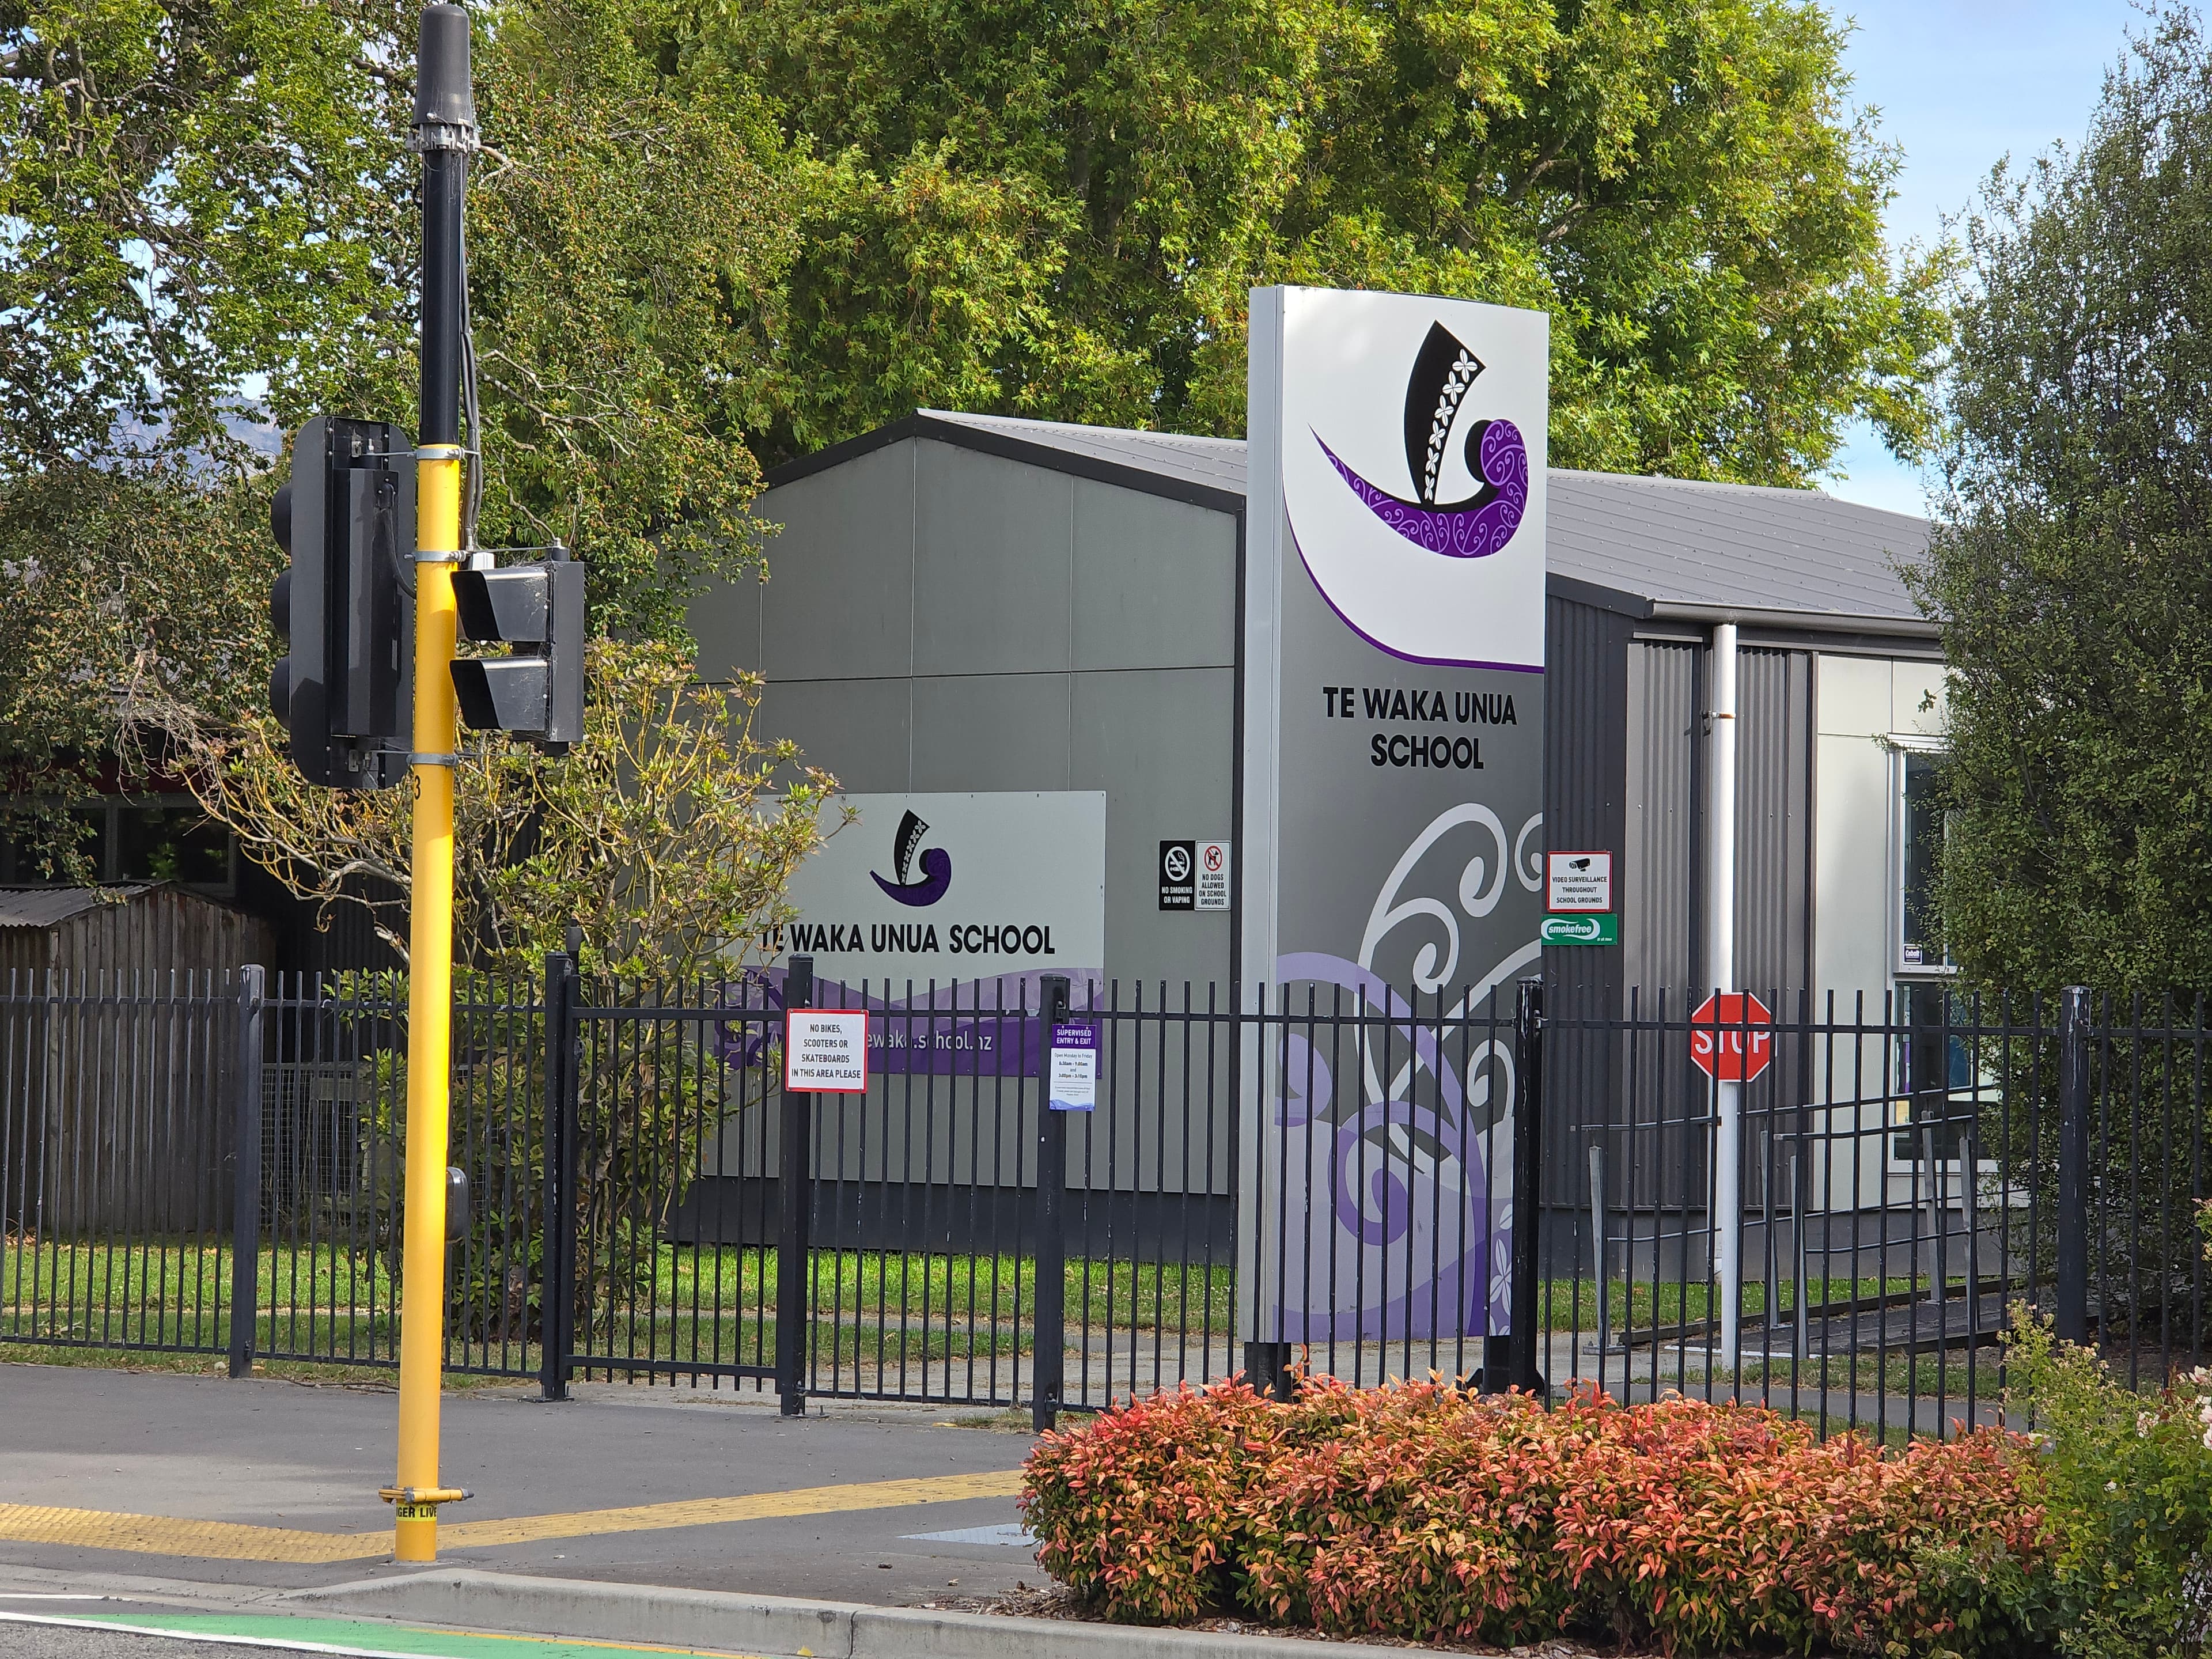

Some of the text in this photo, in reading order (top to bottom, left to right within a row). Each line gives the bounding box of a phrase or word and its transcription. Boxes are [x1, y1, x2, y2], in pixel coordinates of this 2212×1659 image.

[1323, 687, 1517, 725] TE WAKA UNUA
[1370, 733, 1484, 769] SCHOOL
[1548, 924, 1592, 933] smokefree
[790, 924, 865, 952] WAKA
[872, 924, 940, 952] UNUA
[949, 924, 1055, 955] SCHOOL
[810, 1024, 842, 1035] NO BIKES,
[1695, 1021, 1771, 1054] STOP
[804, 1039, 848, 1048] SCOOTERS OR
[801, 1054, 850, 1063] SKATEBOARDS
[791, 1069, 861, 1078] IN THIS AREA PLEASE
[420, 1506, 437, 1518] LIVE
